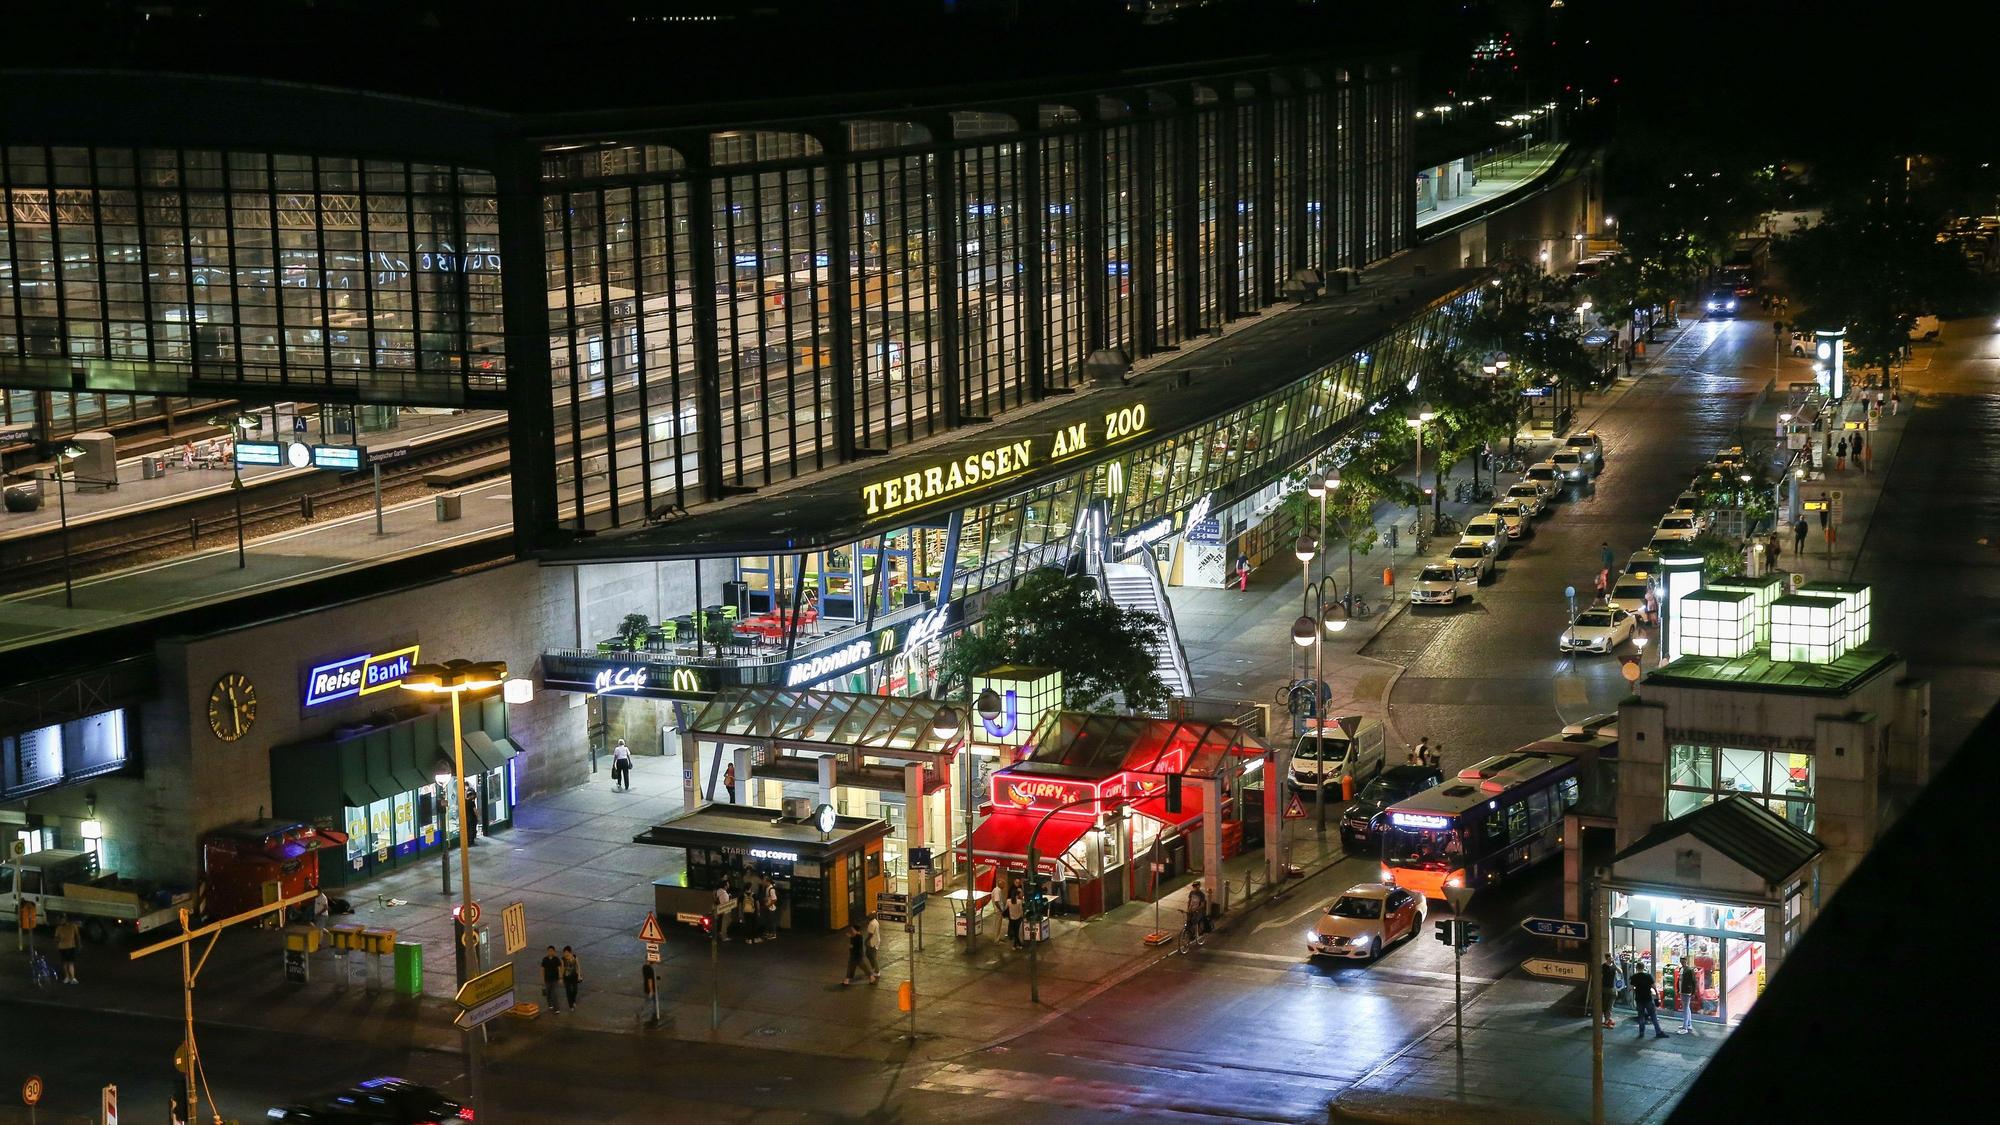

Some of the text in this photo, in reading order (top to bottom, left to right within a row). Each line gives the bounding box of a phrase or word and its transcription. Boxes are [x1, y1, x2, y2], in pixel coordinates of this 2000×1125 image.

[863, 403, 1146, 515] TERRASSEN AM ZOO
[787, 640, 872, 688] McDonald's
[315, 656, 409, 695] Reise Bank
[1018, 782, 1063, 799] CURRY
[721, 845, 798, 862] STARBUCKS COFFEE
[1554, 965, 1575, 975] Tegel
[27, 1083, 39, 1098] 30
